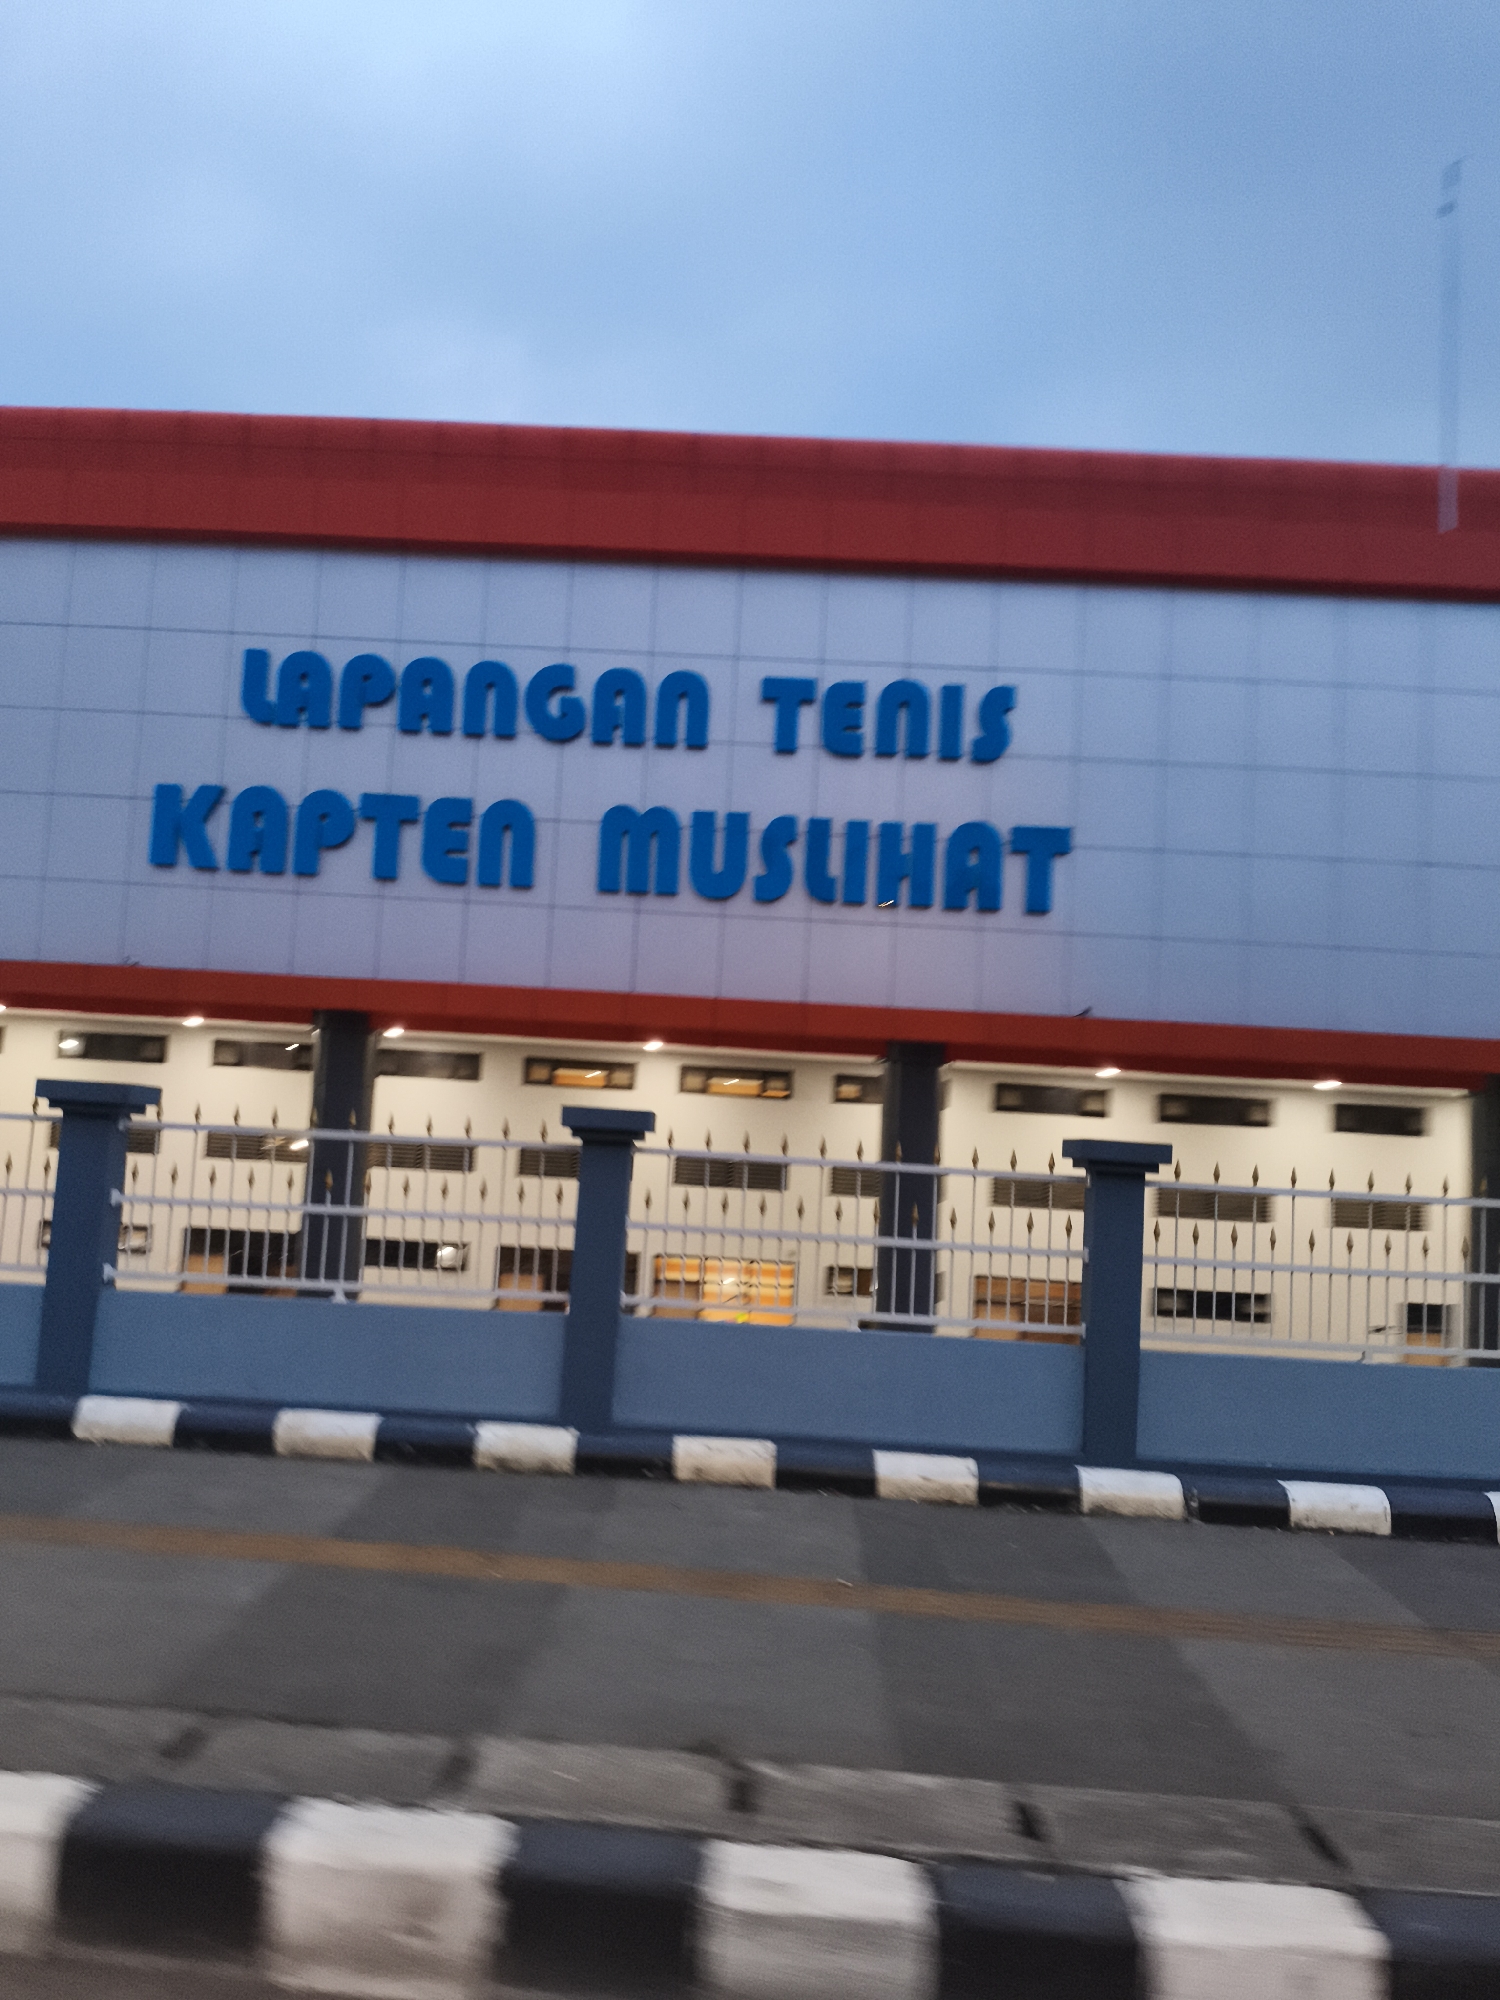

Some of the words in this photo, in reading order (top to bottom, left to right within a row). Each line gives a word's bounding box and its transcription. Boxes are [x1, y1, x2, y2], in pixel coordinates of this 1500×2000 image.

[241, 648, 709, 748] LAPANGAN
[761, 676, 1017, 764] TENIS
[149, 783, 535, 889] KAPTEN
[597, 804, 1073, 914] MUSLIHAT
